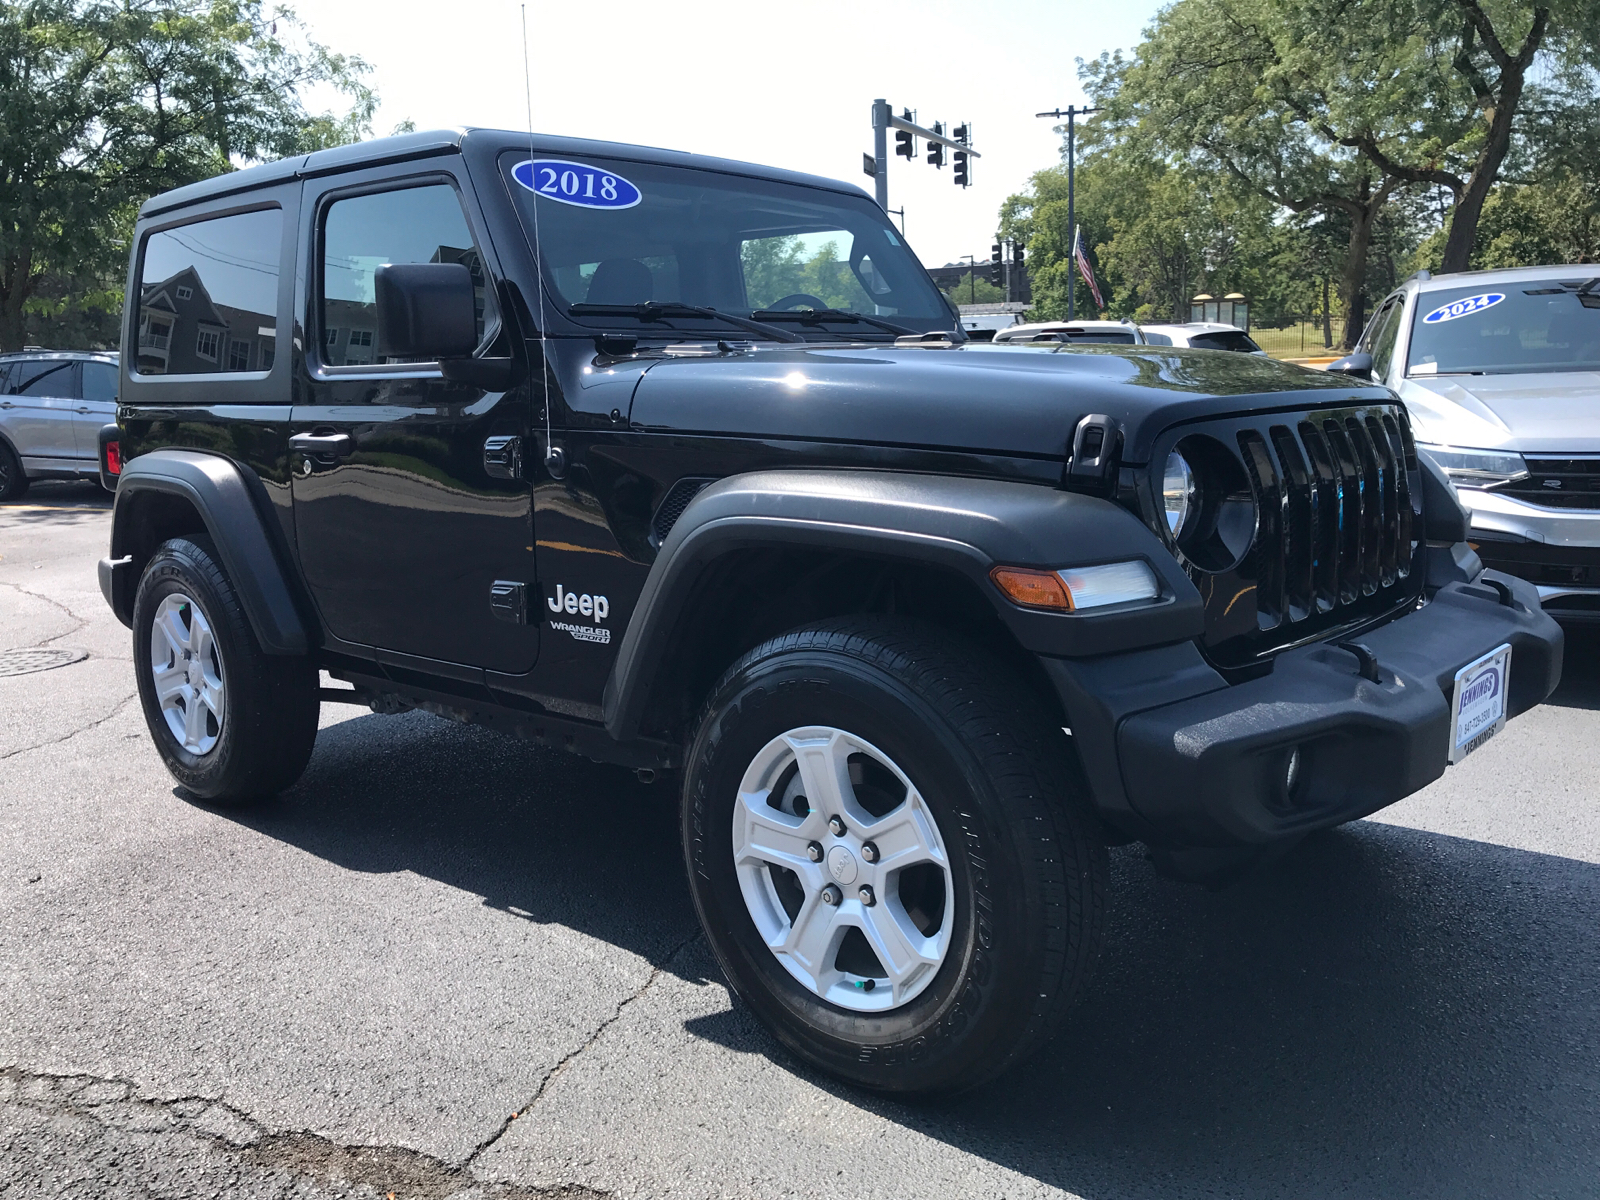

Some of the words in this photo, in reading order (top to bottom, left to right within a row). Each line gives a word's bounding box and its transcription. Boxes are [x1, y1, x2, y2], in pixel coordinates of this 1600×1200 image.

[540, 167, 618, 201] 2018
[1439, 295, 1490, 321] 2024
[547, 584, 609, 624] Jeep
[550, 620, 611, 638] WRANGLER
[573, 632, 610, 643] SPORT
[1458, 674, 1494, 716] JENNINGS
[834, 852, 850, 878] Jeep
